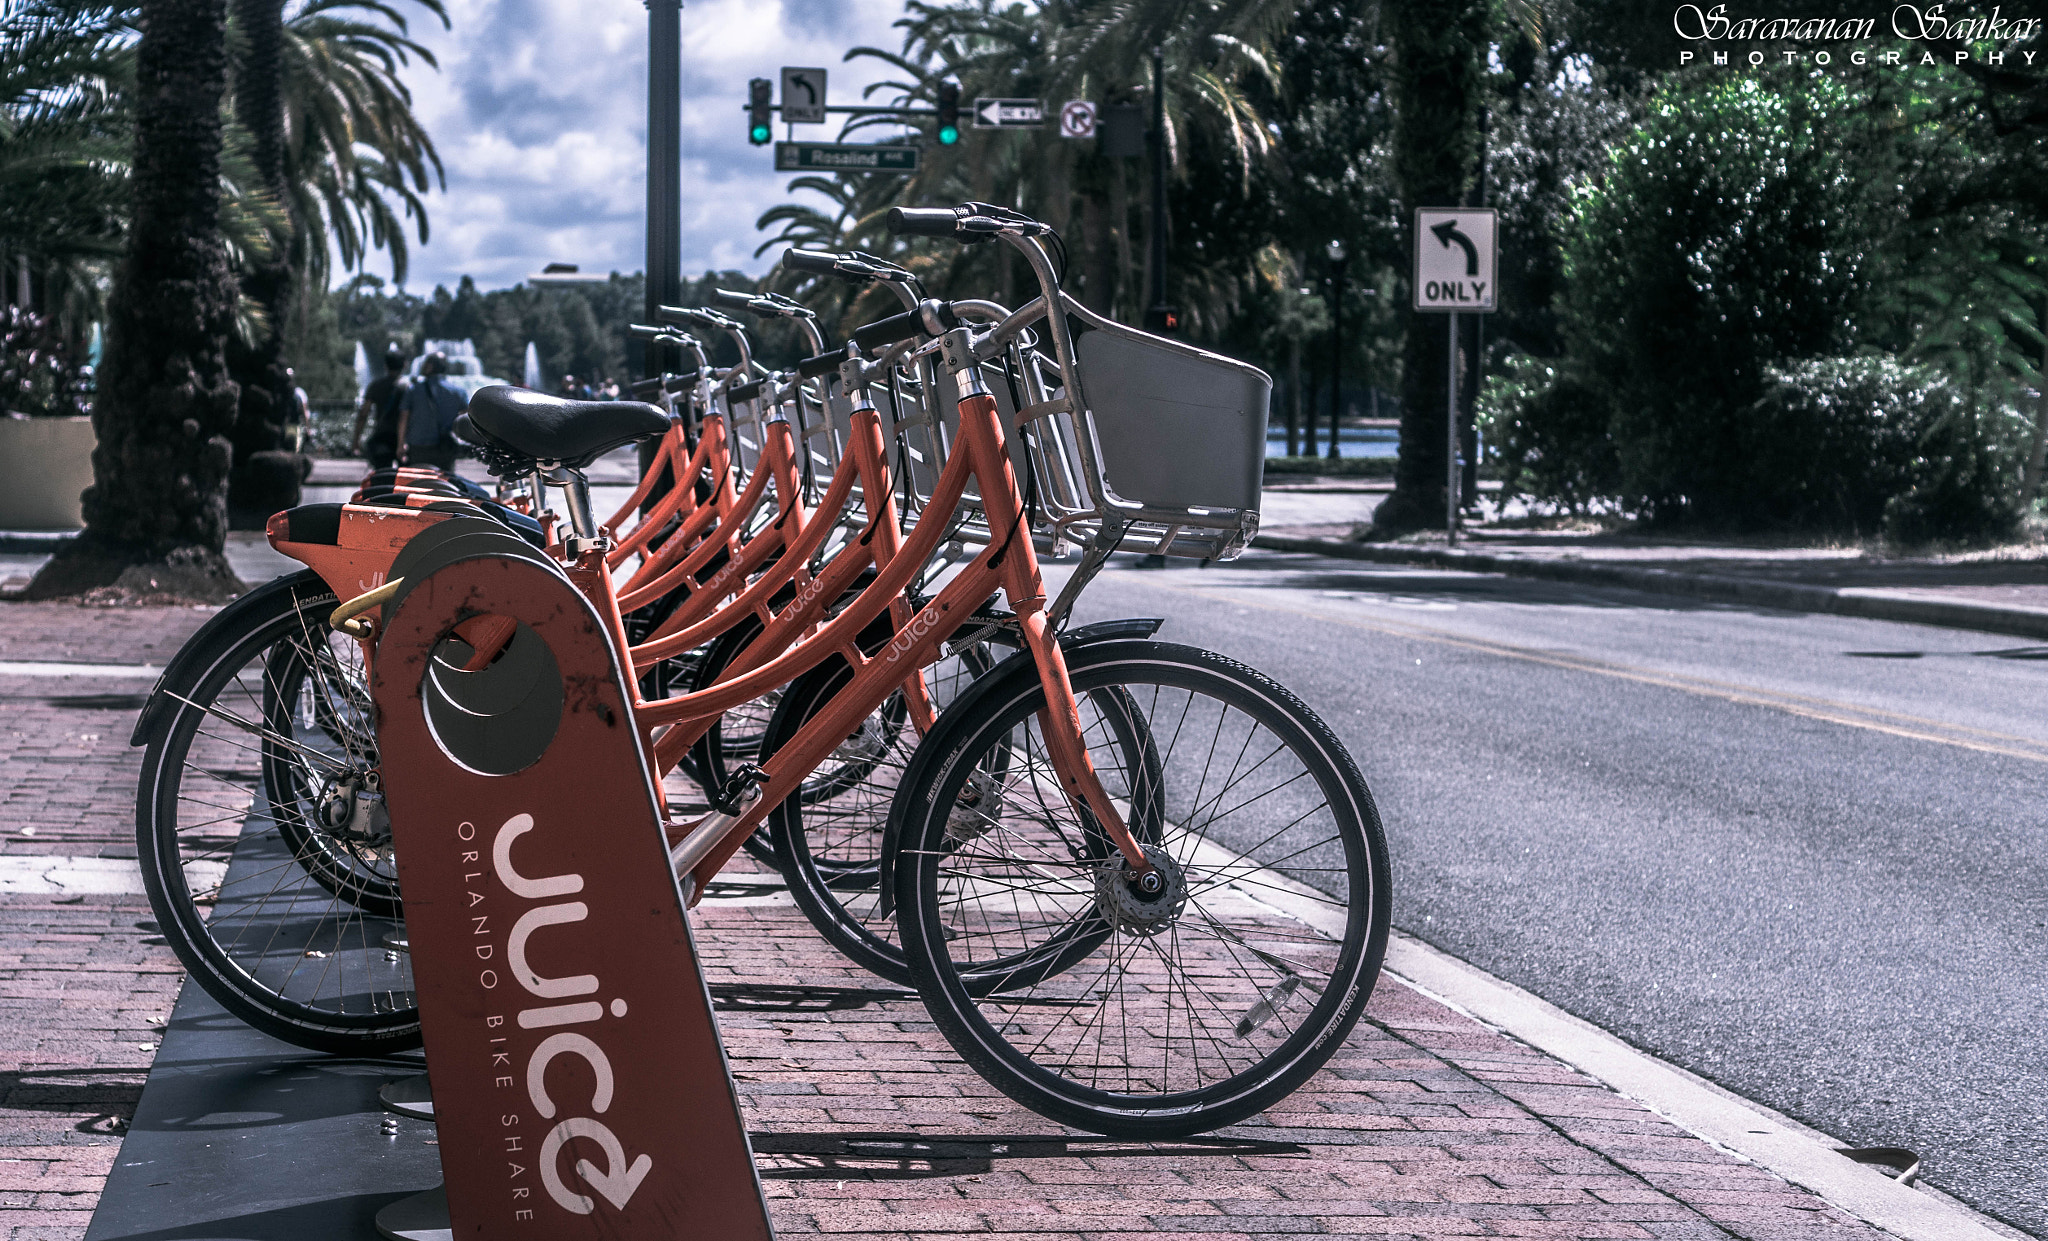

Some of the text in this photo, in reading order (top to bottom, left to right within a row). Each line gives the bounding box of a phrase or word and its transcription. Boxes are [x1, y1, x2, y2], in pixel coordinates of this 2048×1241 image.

[811, 149, 878, 166] Rosalind
[1425, 281, 1486, 302] ONLY
[458, 821, 533, 1222] ORLANDO BIKE SHARE
